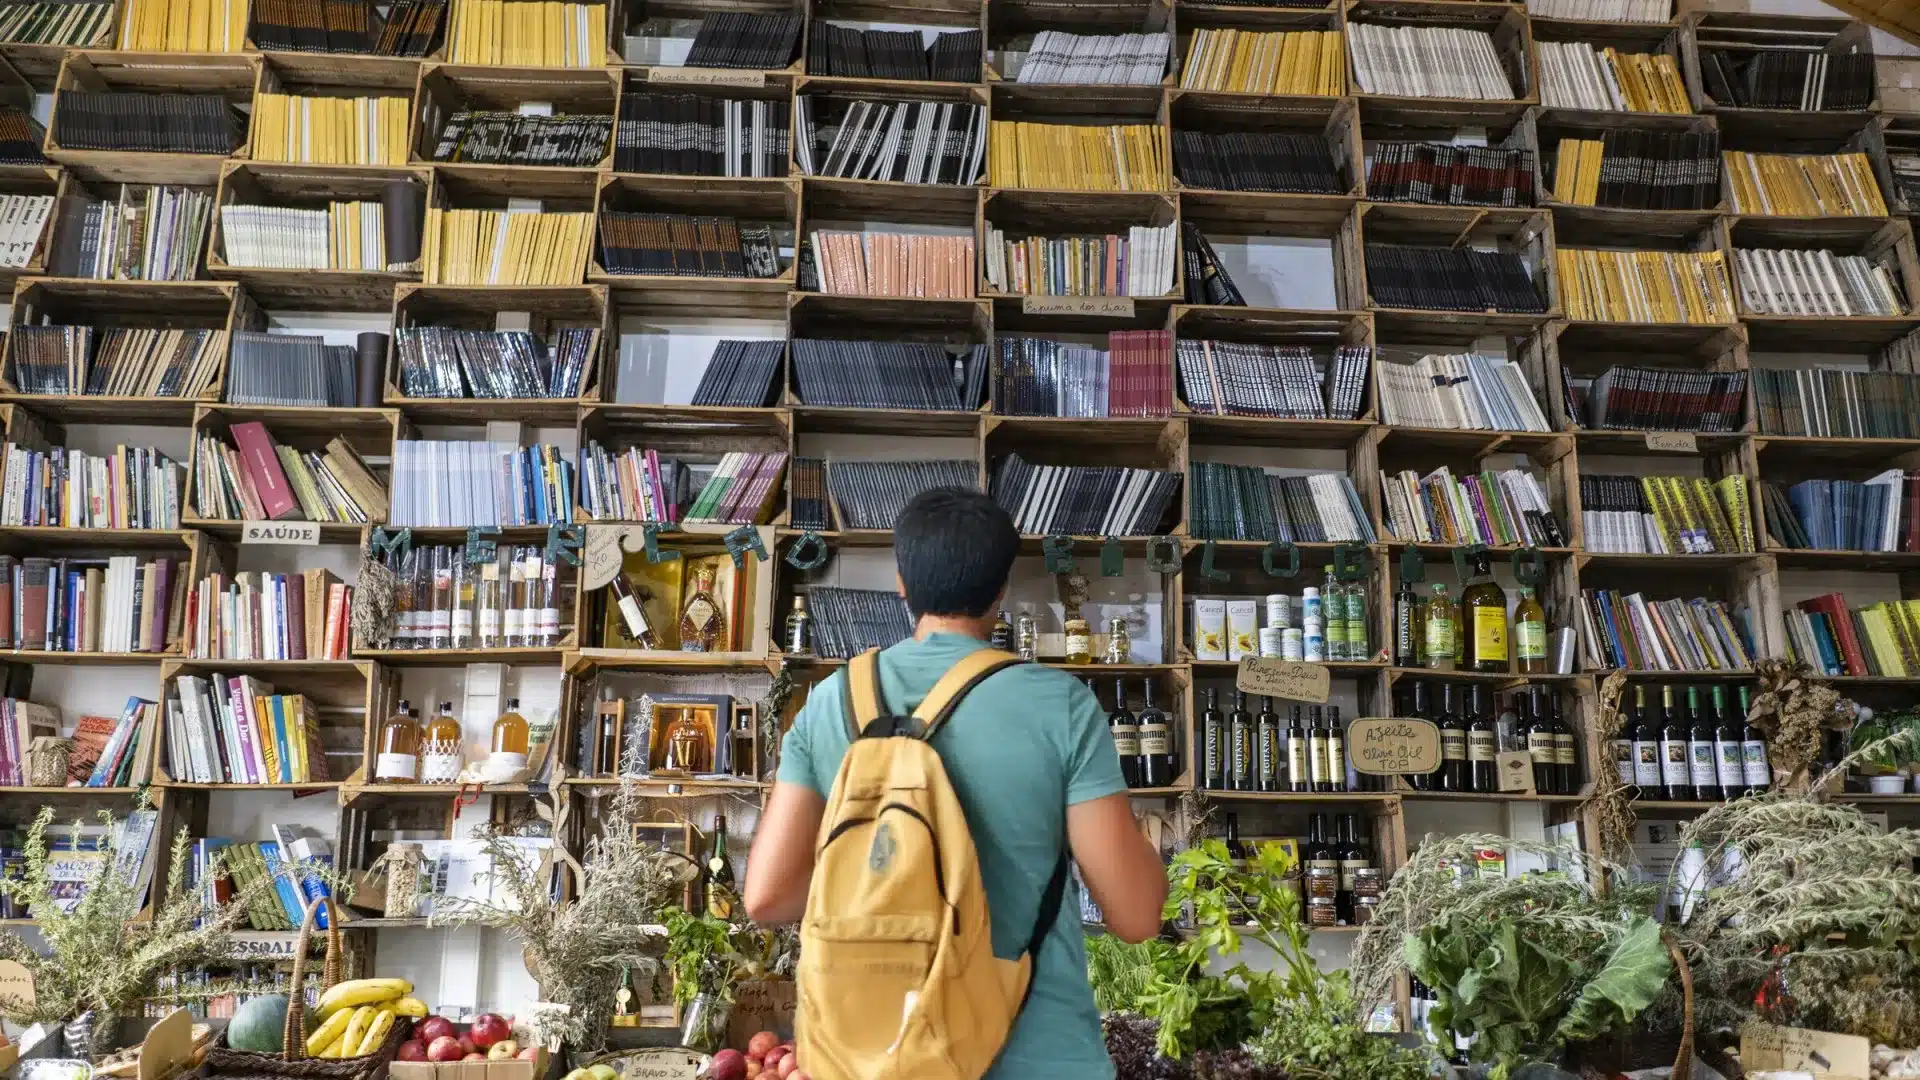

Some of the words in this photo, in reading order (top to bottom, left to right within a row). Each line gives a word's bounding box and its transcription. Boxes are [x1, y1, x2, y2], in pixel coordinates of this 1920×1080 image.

[692, 73, 708, 82] do
[1079, 302, 1097, 312] dos
[1101, 303, 1128, 312] dias
[248, 523, 313, 541] SAÚDE
[1366, 724, 1415, 742] Azeite
[1363, 747, 1394, 760] Olive
[1379, 760, 1408, 770] TOP
[226, 940, 296, 954] ESSOAL
